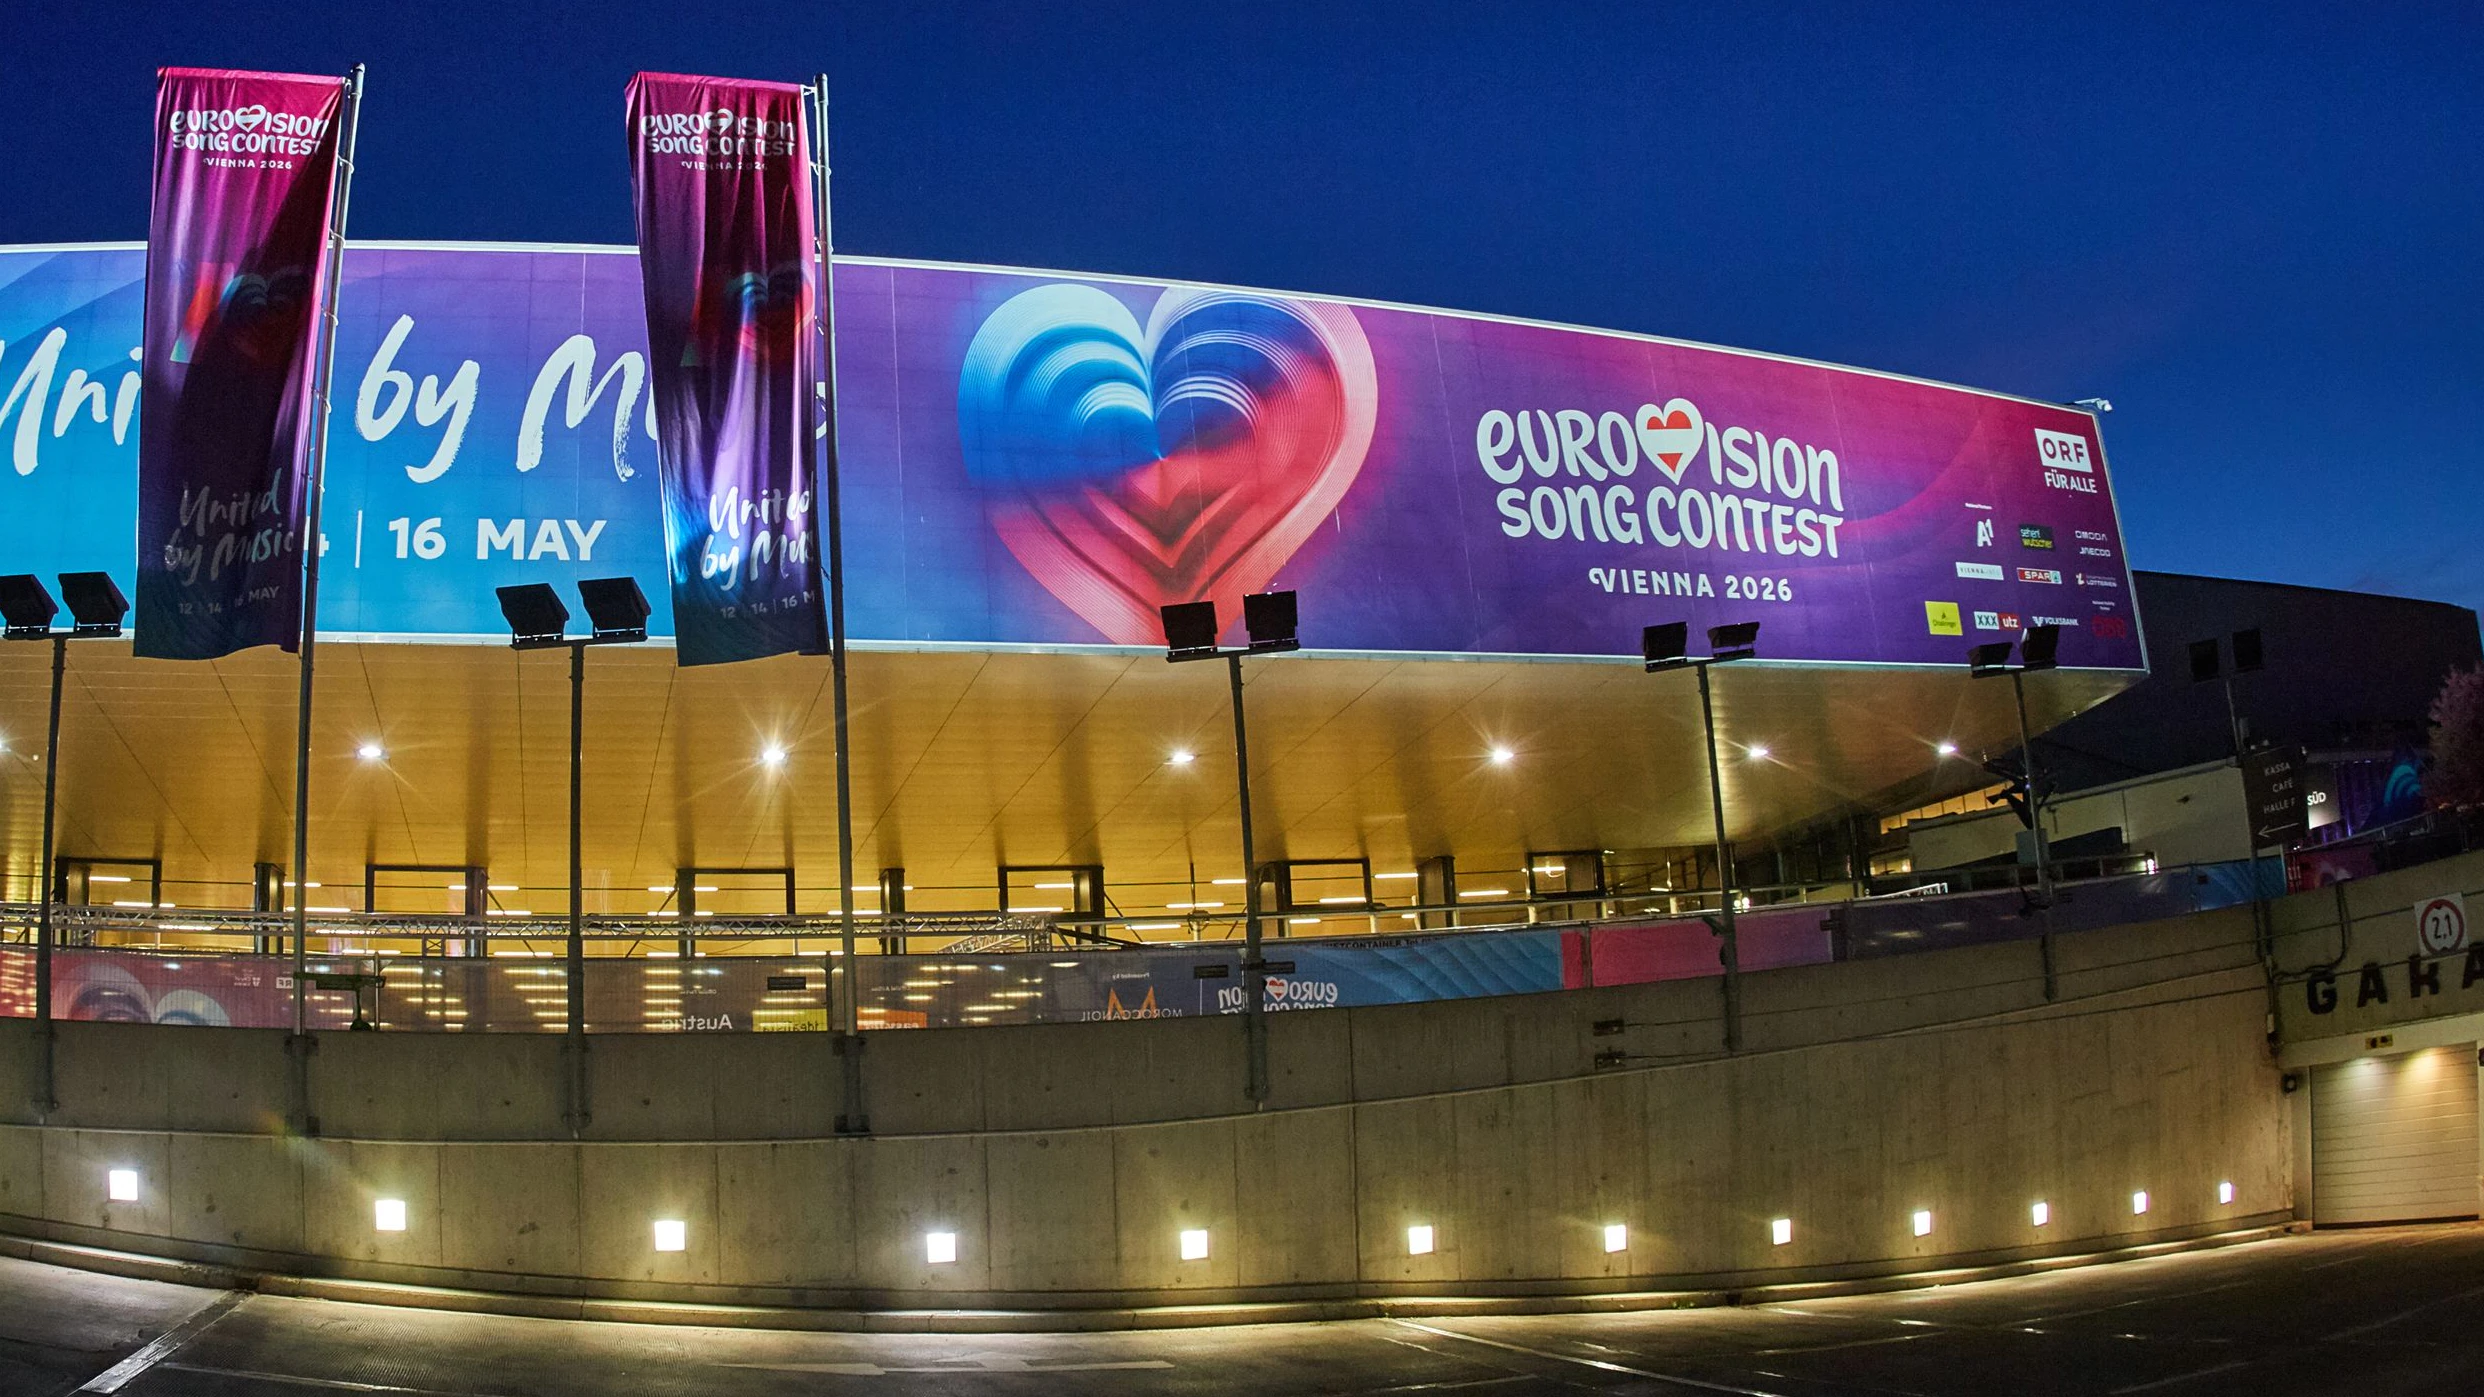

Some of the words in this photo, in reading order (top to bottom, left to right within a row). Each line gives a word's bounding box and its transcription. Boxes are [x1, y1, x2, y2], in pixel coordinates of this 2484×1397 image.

[203, 157, 256, 168] VIENNA
[260, 160, 292, 169] 2026
[355, 314, 480, 484] by
[2042, 436, 2086, 464] ORF
[2044, 468, 2070, 490] FÜR
[2070, 476, 2098, 494] ALLE
[1496, 484, 1644, 545] SONG
[1645, 485, 1844, 559] CONTEST
[1977, 518, 1994, 547] A1
[388, 518, 447, 561] 16
[476, 517, 608, 562] MAY
[701, 533, 740, 592] by
[2024, 570, 2050, 581] SPAR
[249, 585, 280, 602] MAY
[1588, 567, 1716, 598] VIENNA
[1724, 574, 1793, 602] 2026
[720, 606, 736, 619] 12
[751, 602, 767, 615] 14
[782, 595, 798, 610] 16
[2264, 761, 2291, 776] KASSA
[2263, 799, 2290, 814] HALLE
[2432, 914, 2453, 940] 2,1
